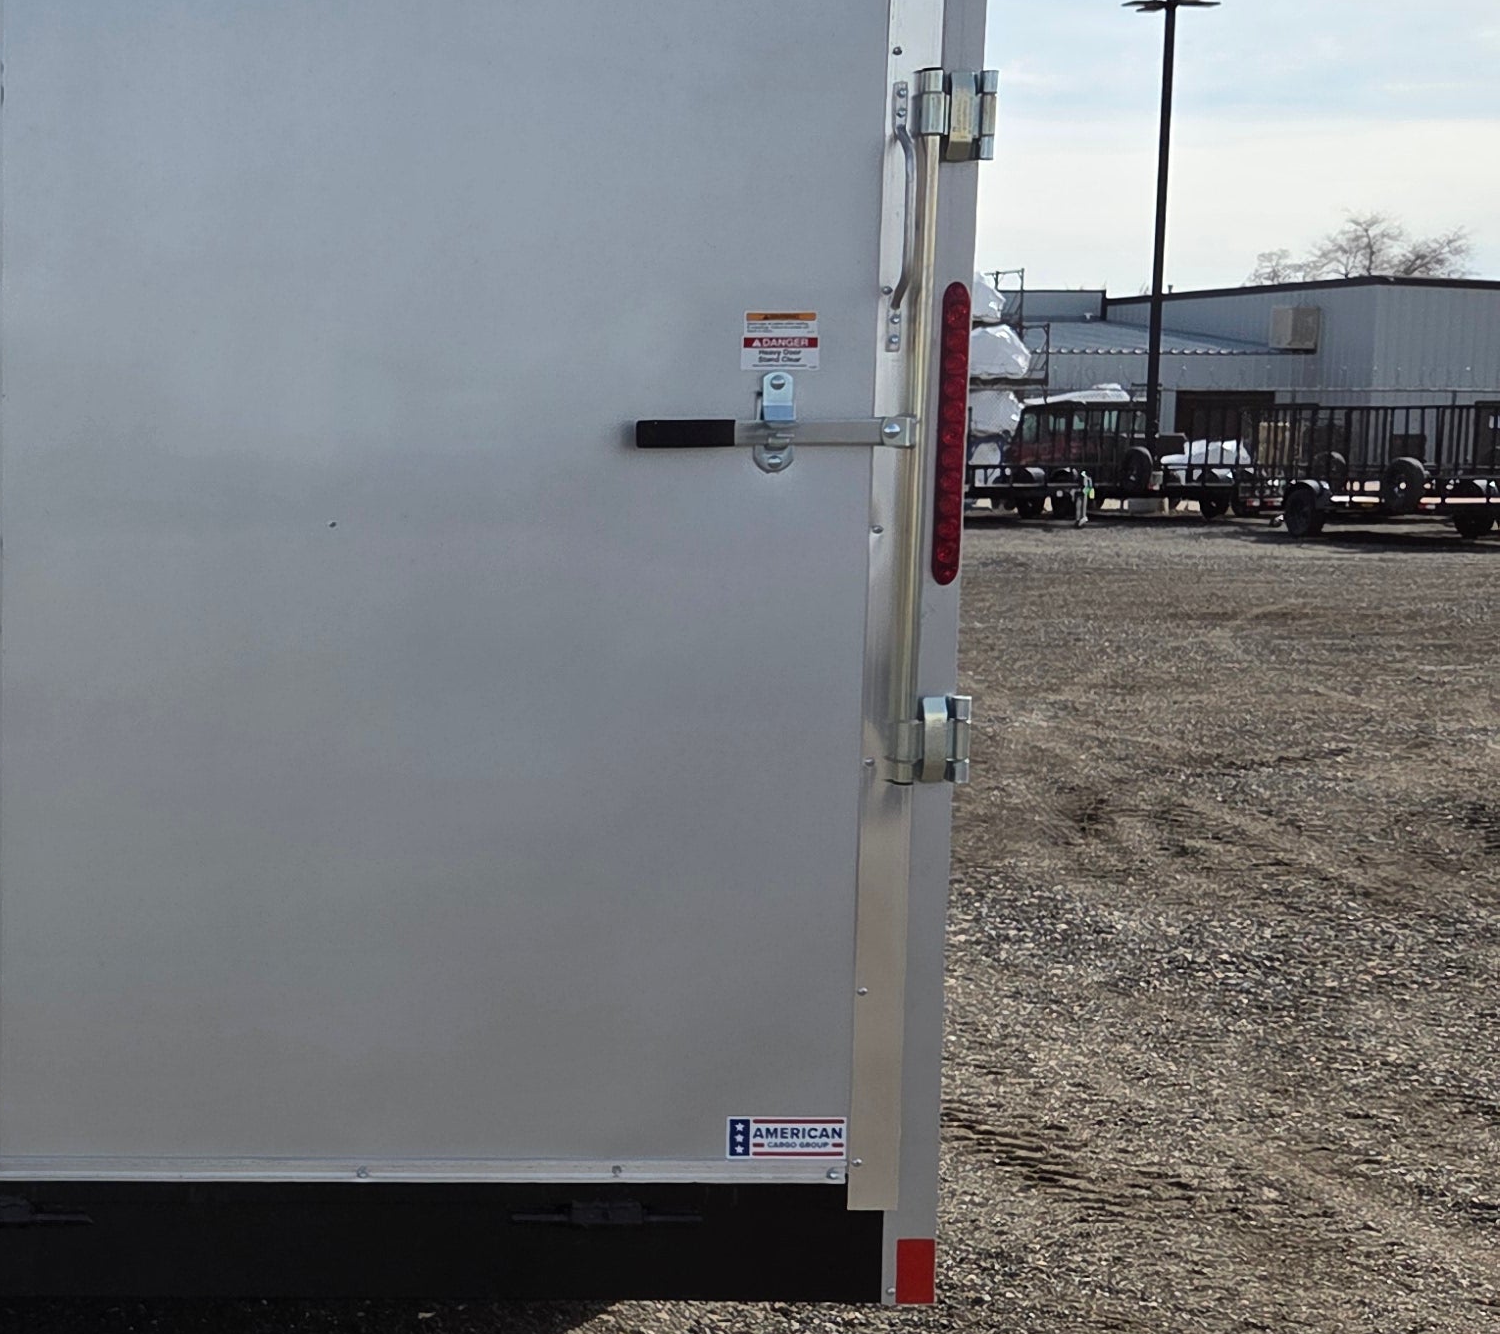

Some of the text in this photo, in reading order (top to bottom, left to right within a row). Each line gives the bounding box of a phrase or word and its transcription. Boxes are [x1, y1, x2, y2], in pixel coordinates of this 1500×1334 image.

[762, 338, 809, 347] DANGER
[752, 1127, 843, 1140] AMERICAN
[767, 1141, 830, 1149] CARGO GROUP
